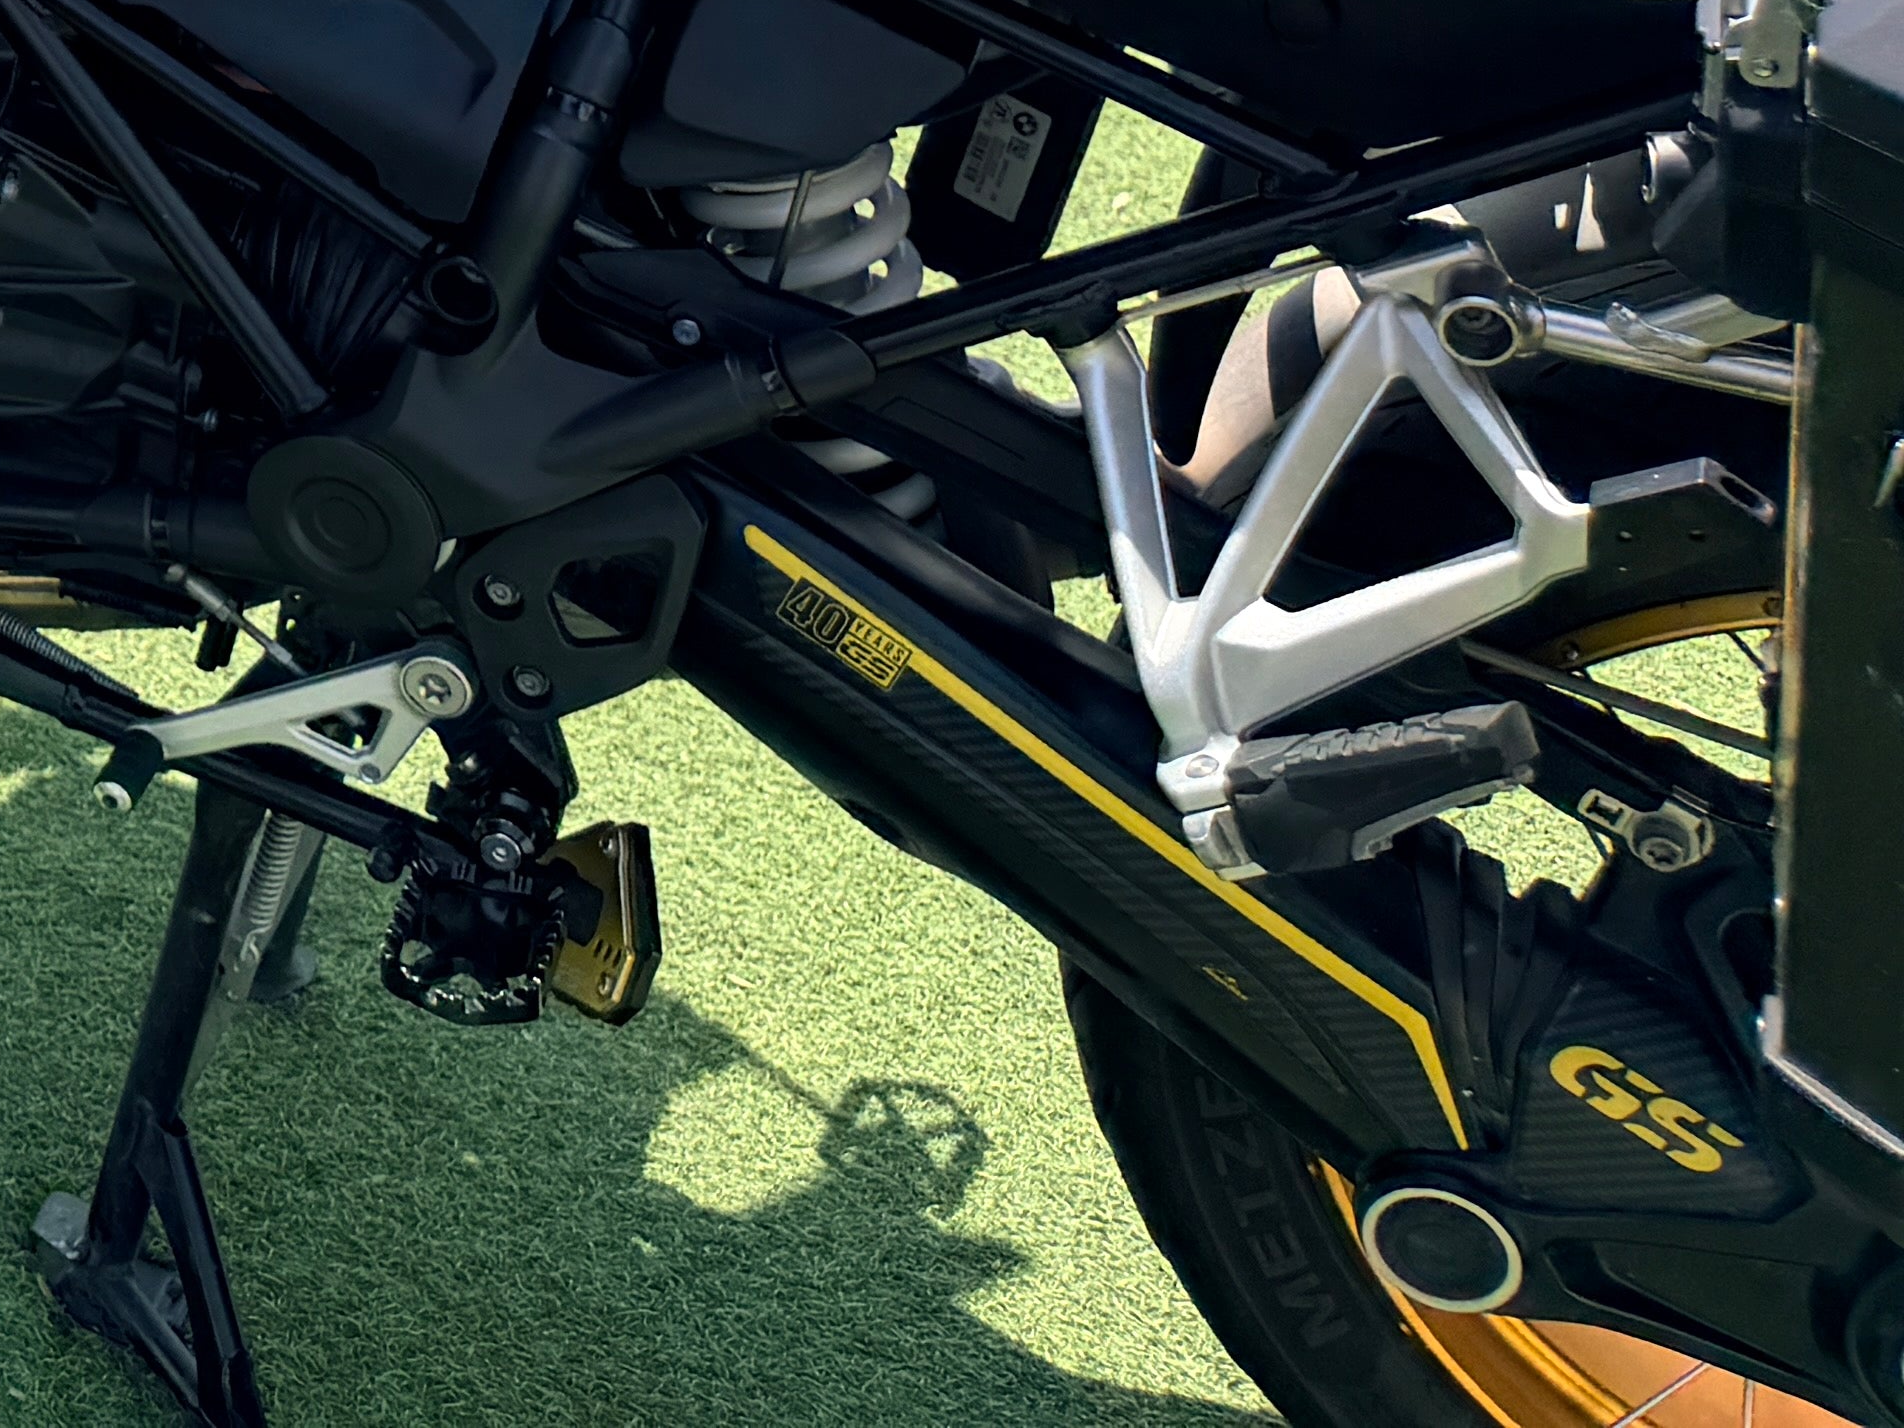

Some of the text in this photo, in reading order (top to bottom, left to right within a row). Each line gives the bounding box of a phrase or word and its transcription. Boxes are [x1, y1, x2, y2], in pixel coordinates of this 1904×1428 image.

[785, 585, 908, 663] 40 YEARS
[838, 639, 897, 681] GS
[1548, 1044, 1746, 1174] GS
